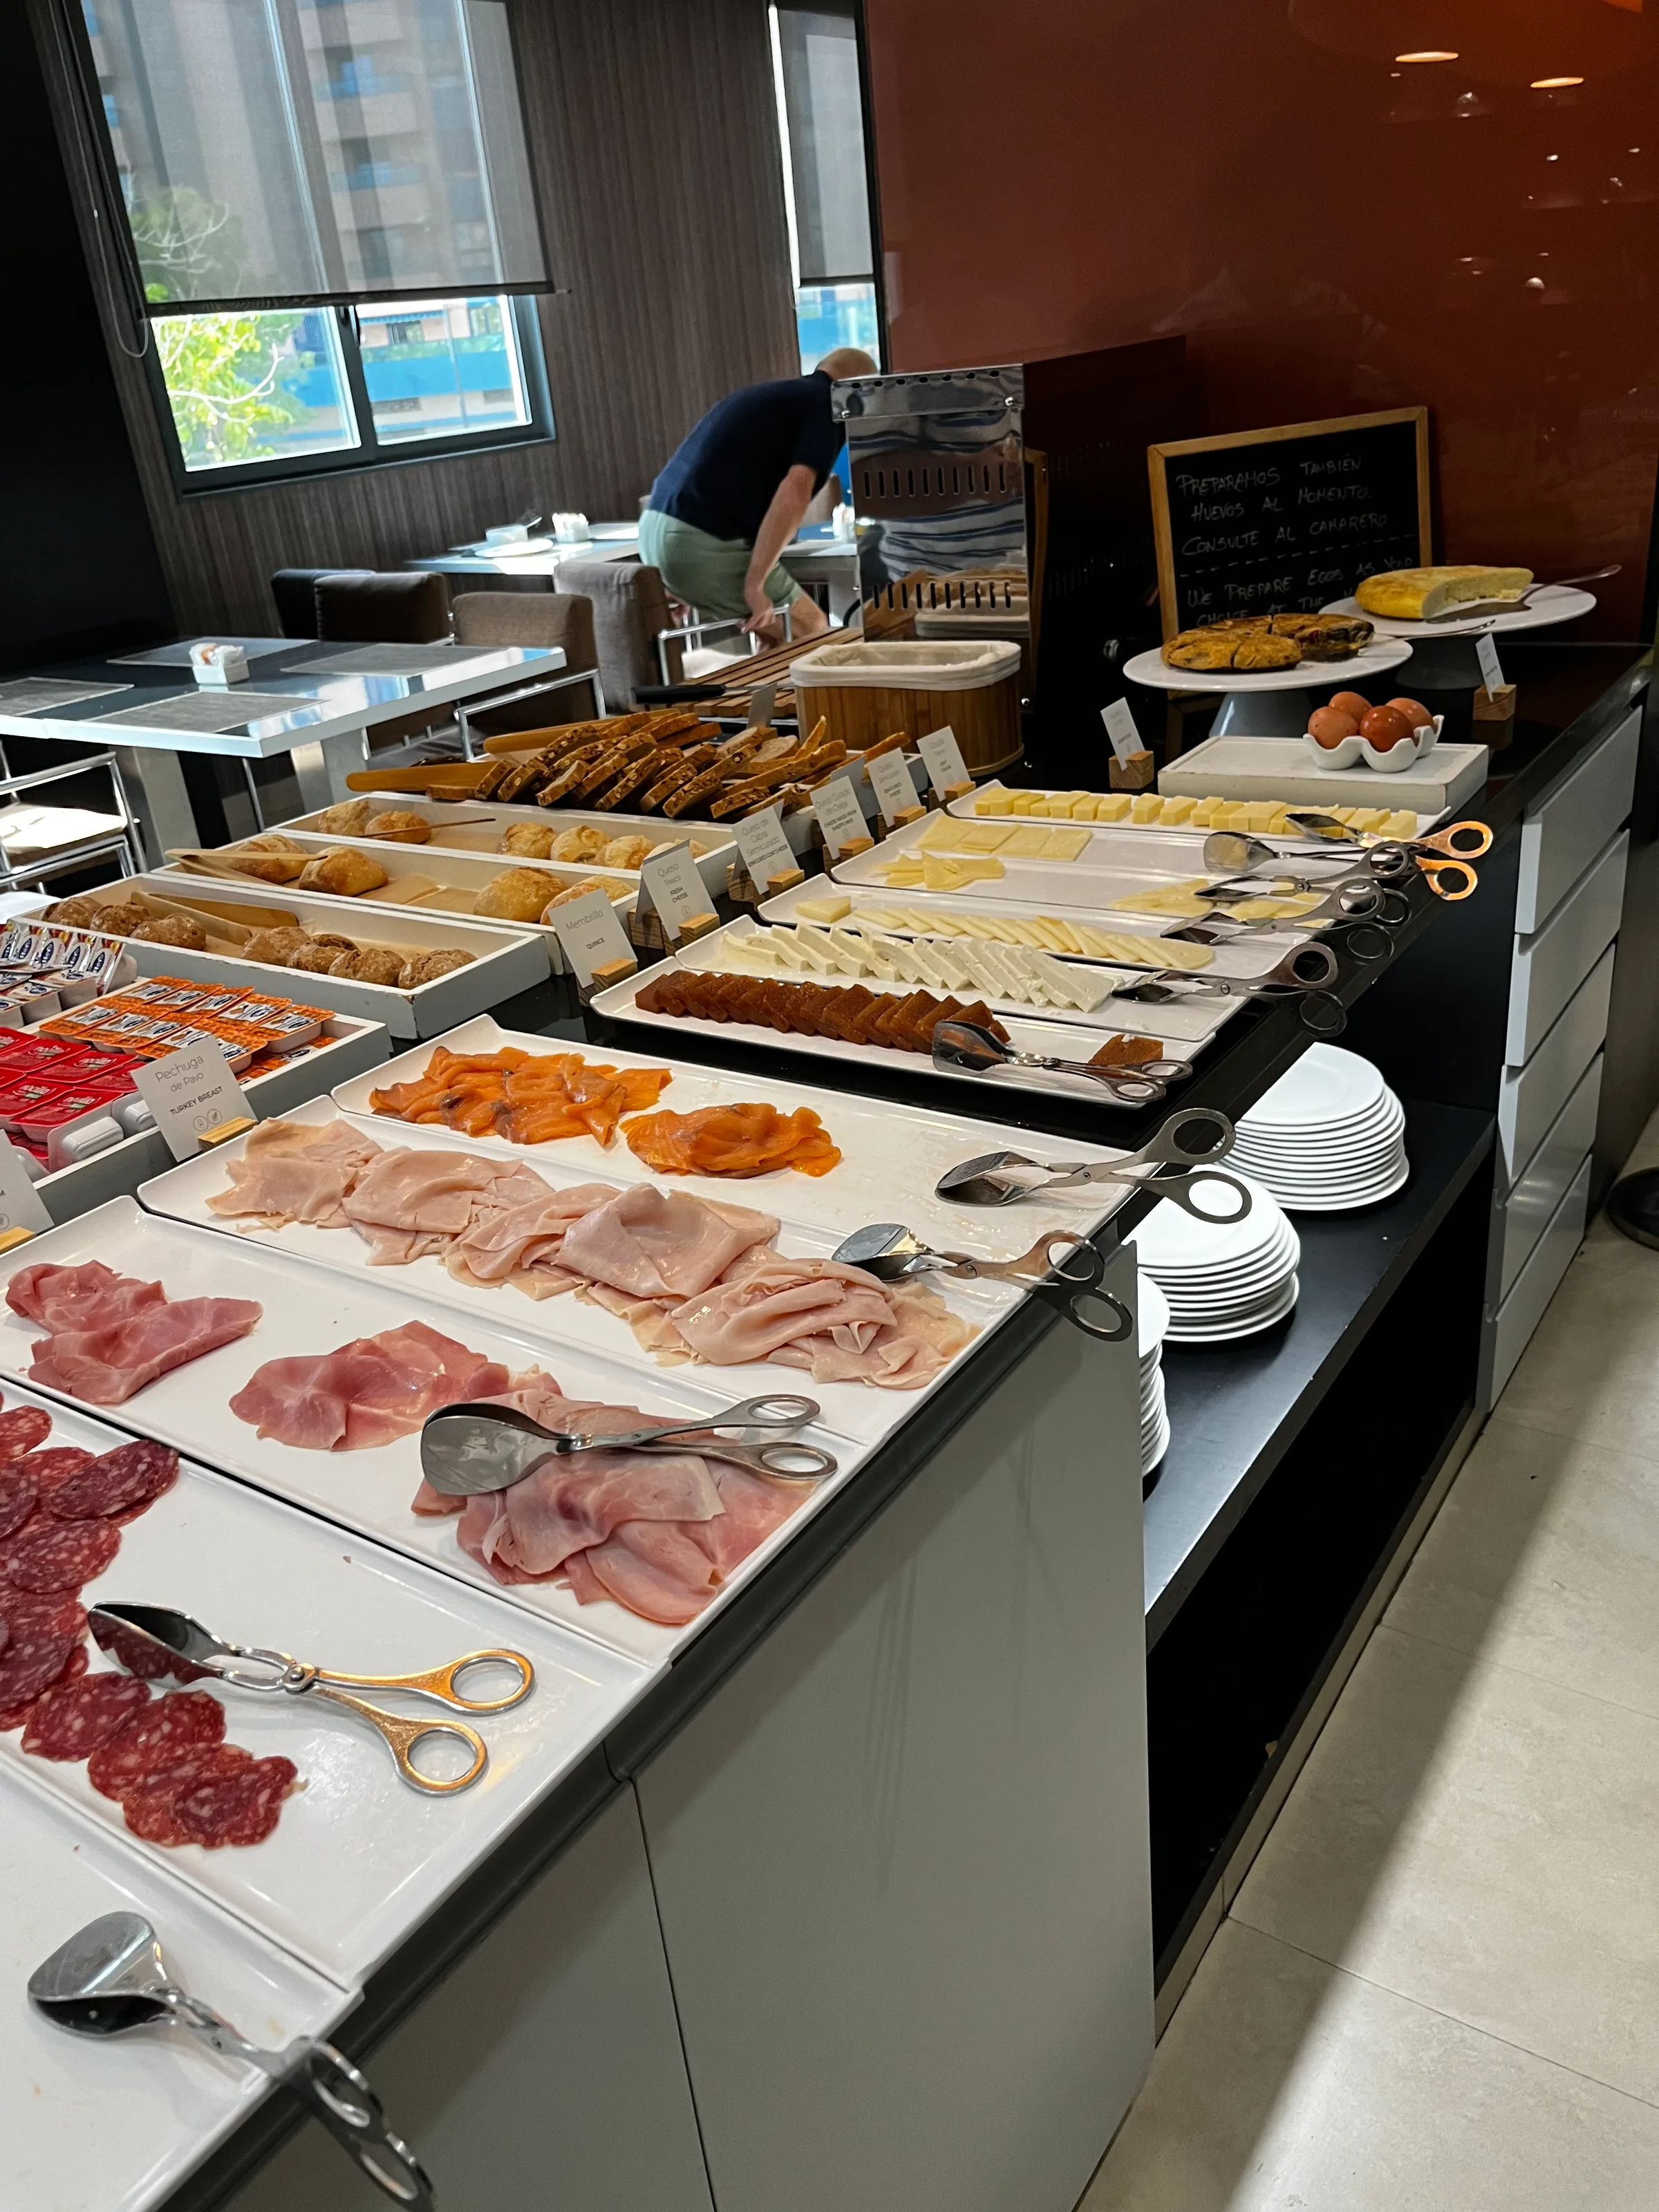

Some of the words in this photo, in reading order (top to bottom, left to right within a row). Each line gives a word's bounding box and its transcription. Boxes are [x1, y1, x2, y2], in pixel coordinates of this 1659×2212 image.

[1175, 467, 1280, 498] PREPARAMOS
[1190, 502, 1244, 521] HUEVOS
[1262, 496, 1283, 512] AL
[1181, 529, 1259, 556] CONSULTE
[1275, 526, 1296, 543] AL
[1309, 512, 1388, 536] CAMARERO
[1188, 587, 1213, 608] WE
[1224, 577, 1294, 601] PREPARE
[1356, 562, 1375, 577] AS
[1298, 597, 1325, 612] THE
[657, 863, 679, 877] Queso
[671, 892, 688, 903] CHEESE
[565, 910, 604, 931] Membrillo
[586, 937, 606, 949] QUINCE
[155, 1056, 204, 1082] Pechuga
[170, 1083, 182, 1092] de
[182, 1072, 204, 1086] Pavo
[169, 1098, 197, 1116] TURKEY
[197, 1086, 223, 1103] BREAST
